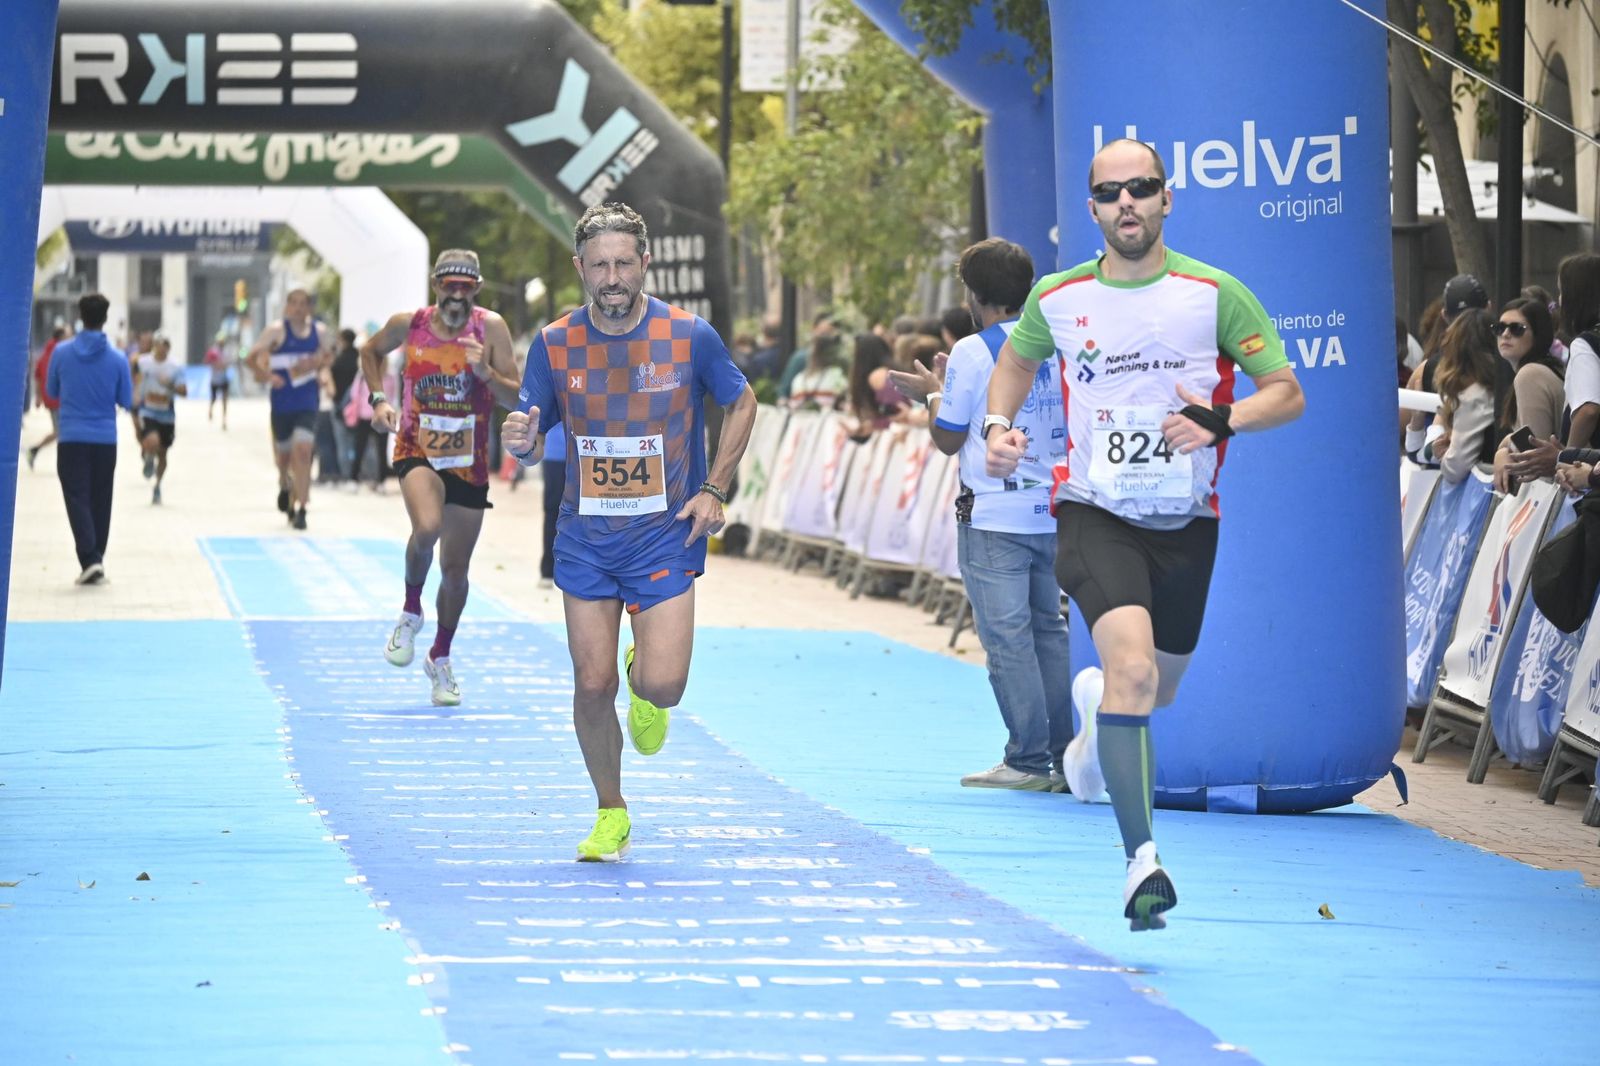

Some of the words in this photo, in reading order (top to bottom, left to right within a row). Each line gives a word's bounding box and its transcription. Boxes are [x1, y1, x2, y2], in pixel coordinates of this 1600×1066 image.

[1259, 192, 1342, 222] original
[1327, 309, 1345, 327] de
[1105, 361, 1150, 376] running
[1152, 359, 1160, 369] &
[1163, 359, 1187, 369] trail
[427, 430, 465, 449] 228
[1107, 431, 1174, 464] 824
[592, 457, 651, 487] 554
[1114, 480, 1160, 492] Huelva
[600, 498, 639, 509] Huelva
